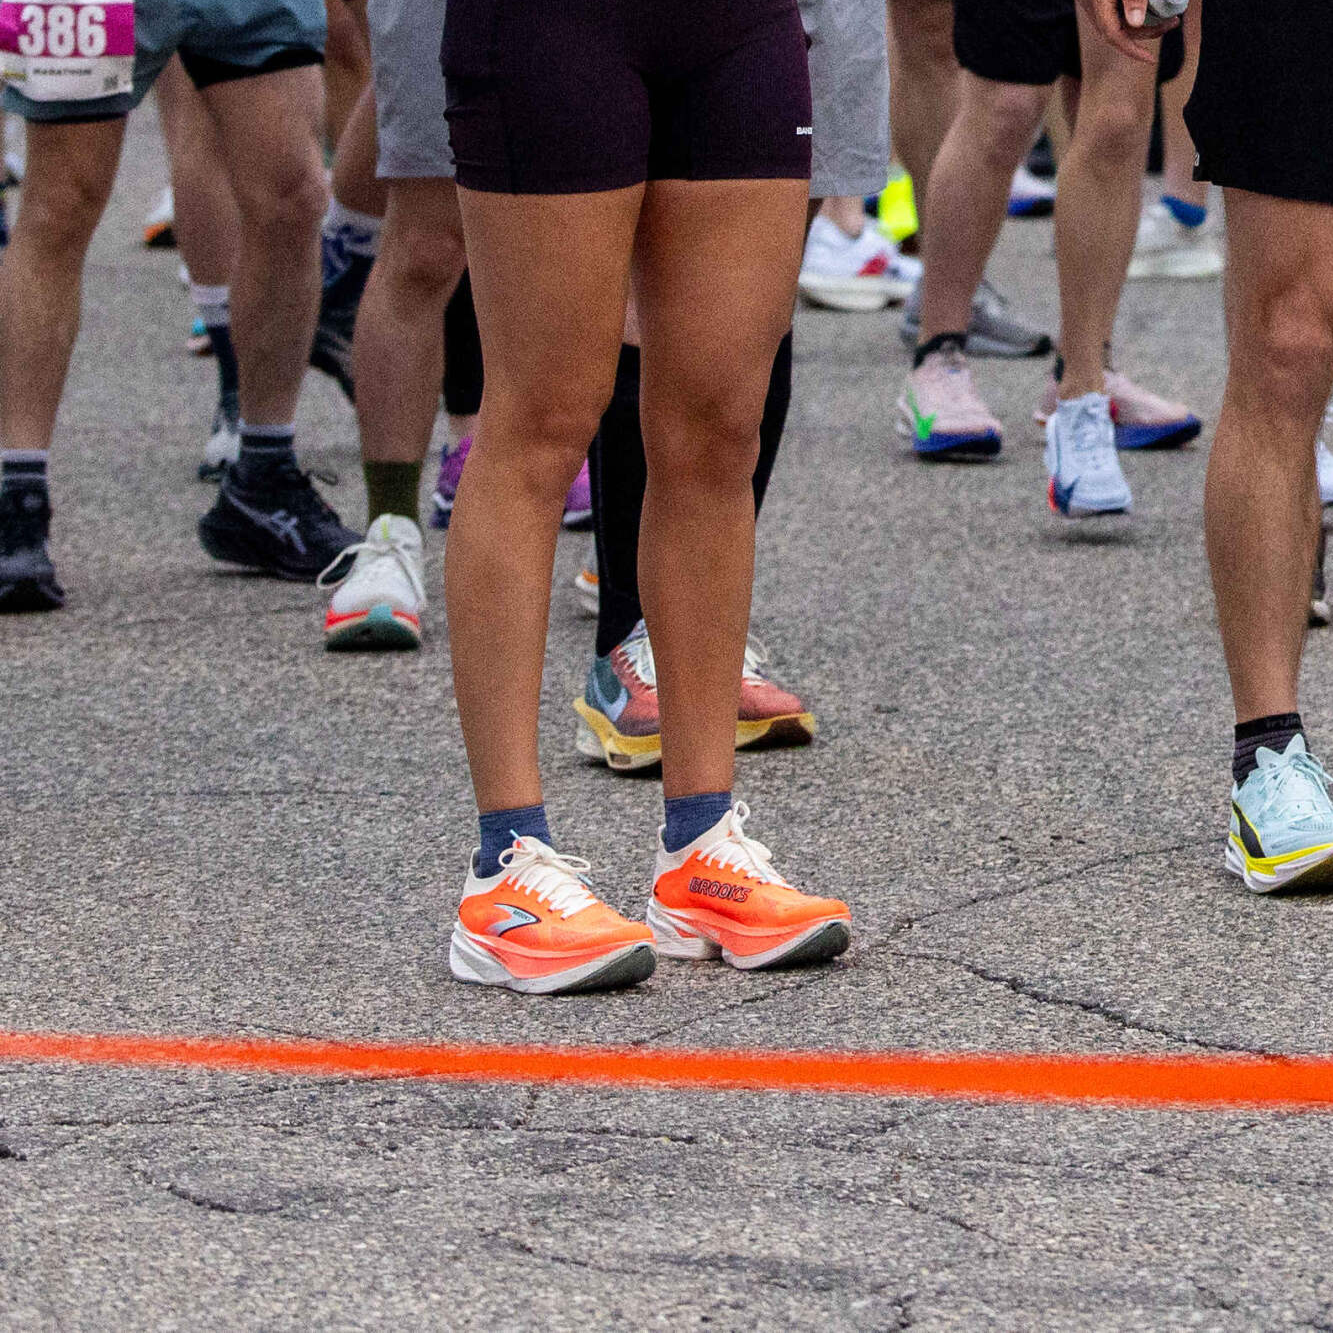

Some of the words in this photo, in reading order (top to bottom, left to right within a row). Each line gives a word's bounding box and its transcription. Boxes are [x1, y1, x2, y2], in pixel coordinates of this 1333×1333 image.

[18, 4, 107, 58] 386
[33, 67, 92, 76] MARATHON
[689, 876, 752, 902] BROOKS
